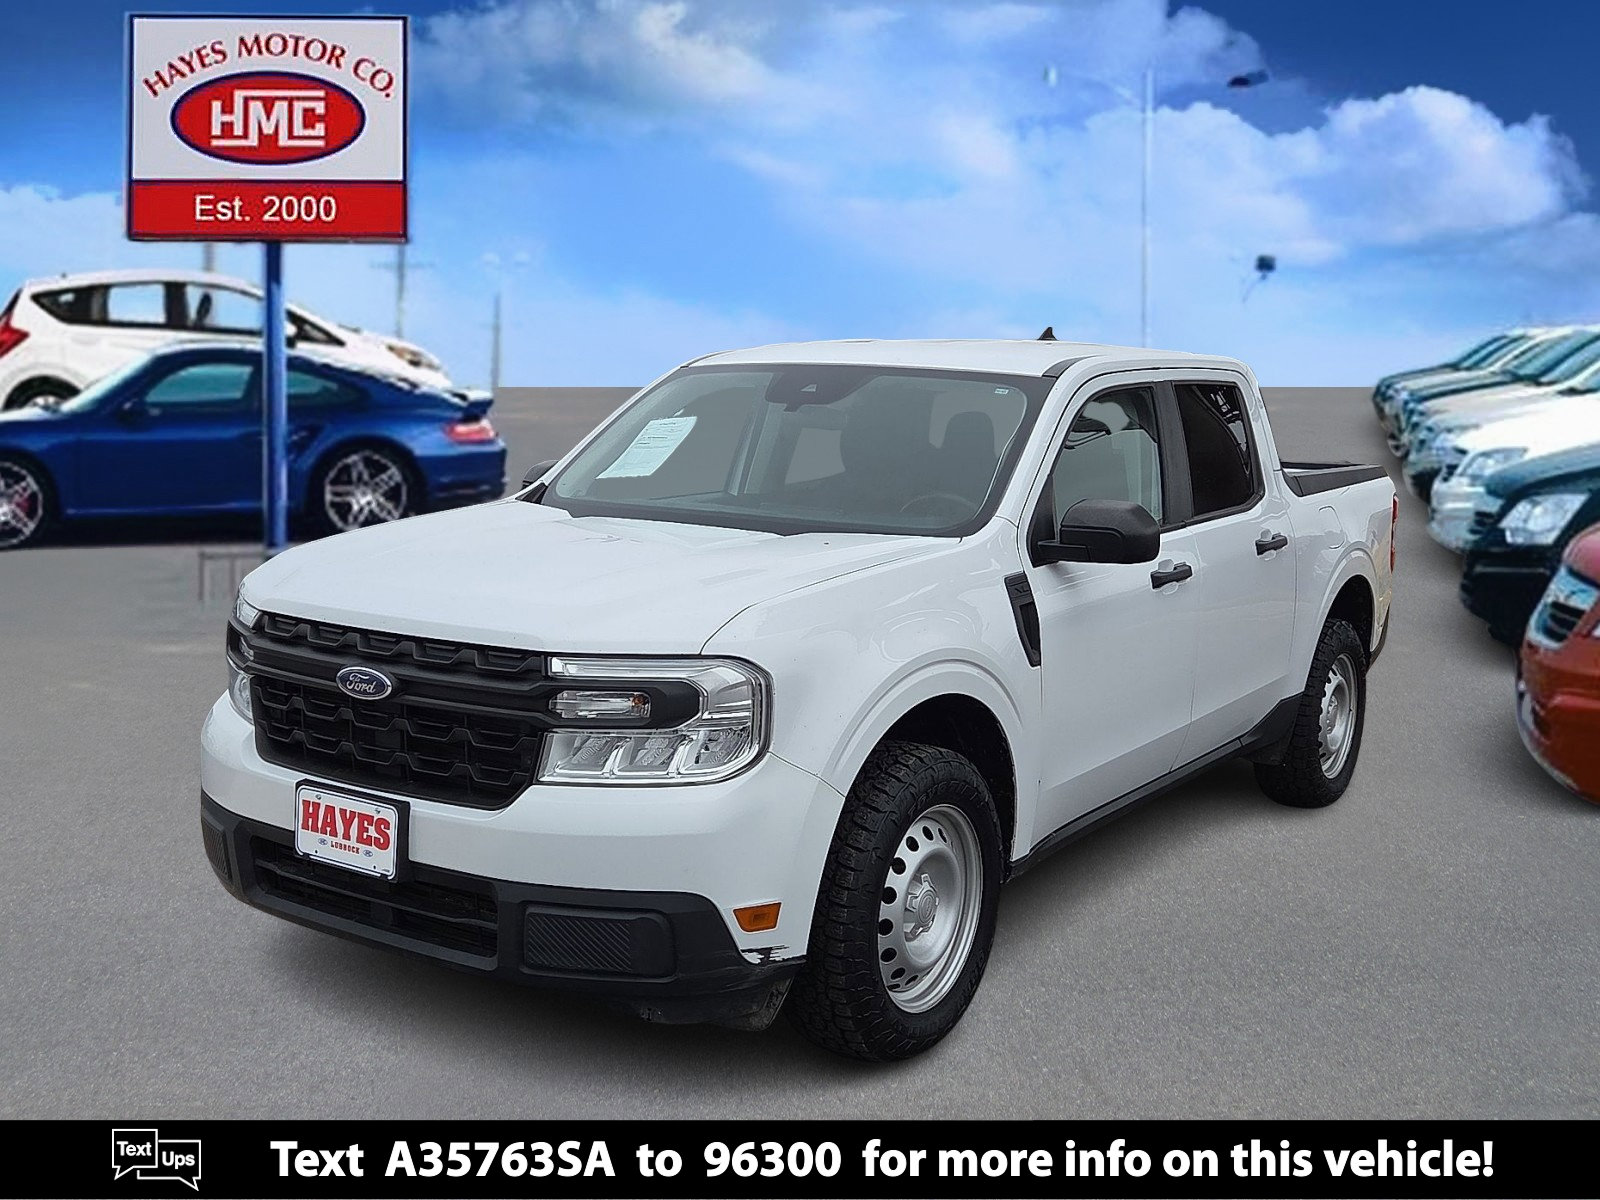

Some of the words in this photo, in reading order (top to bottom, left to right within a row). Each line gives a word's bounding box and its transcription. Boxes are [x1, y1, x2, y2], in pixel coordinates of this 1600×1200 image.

[142, 40, 228, 97] HAYES
[238, 33, 347, 70] MOTOR
[352, 57, 395, 98] CO.
[210, 89, 326, 147] HMC
[194, 194, 250, 222] Est.
[262, 195, 337, 222] 2000
[346, 671, 376, 694] Ford
[301, 798, 391, 851] HAYES
[330, 840, 361, 855] LUBBOCK
